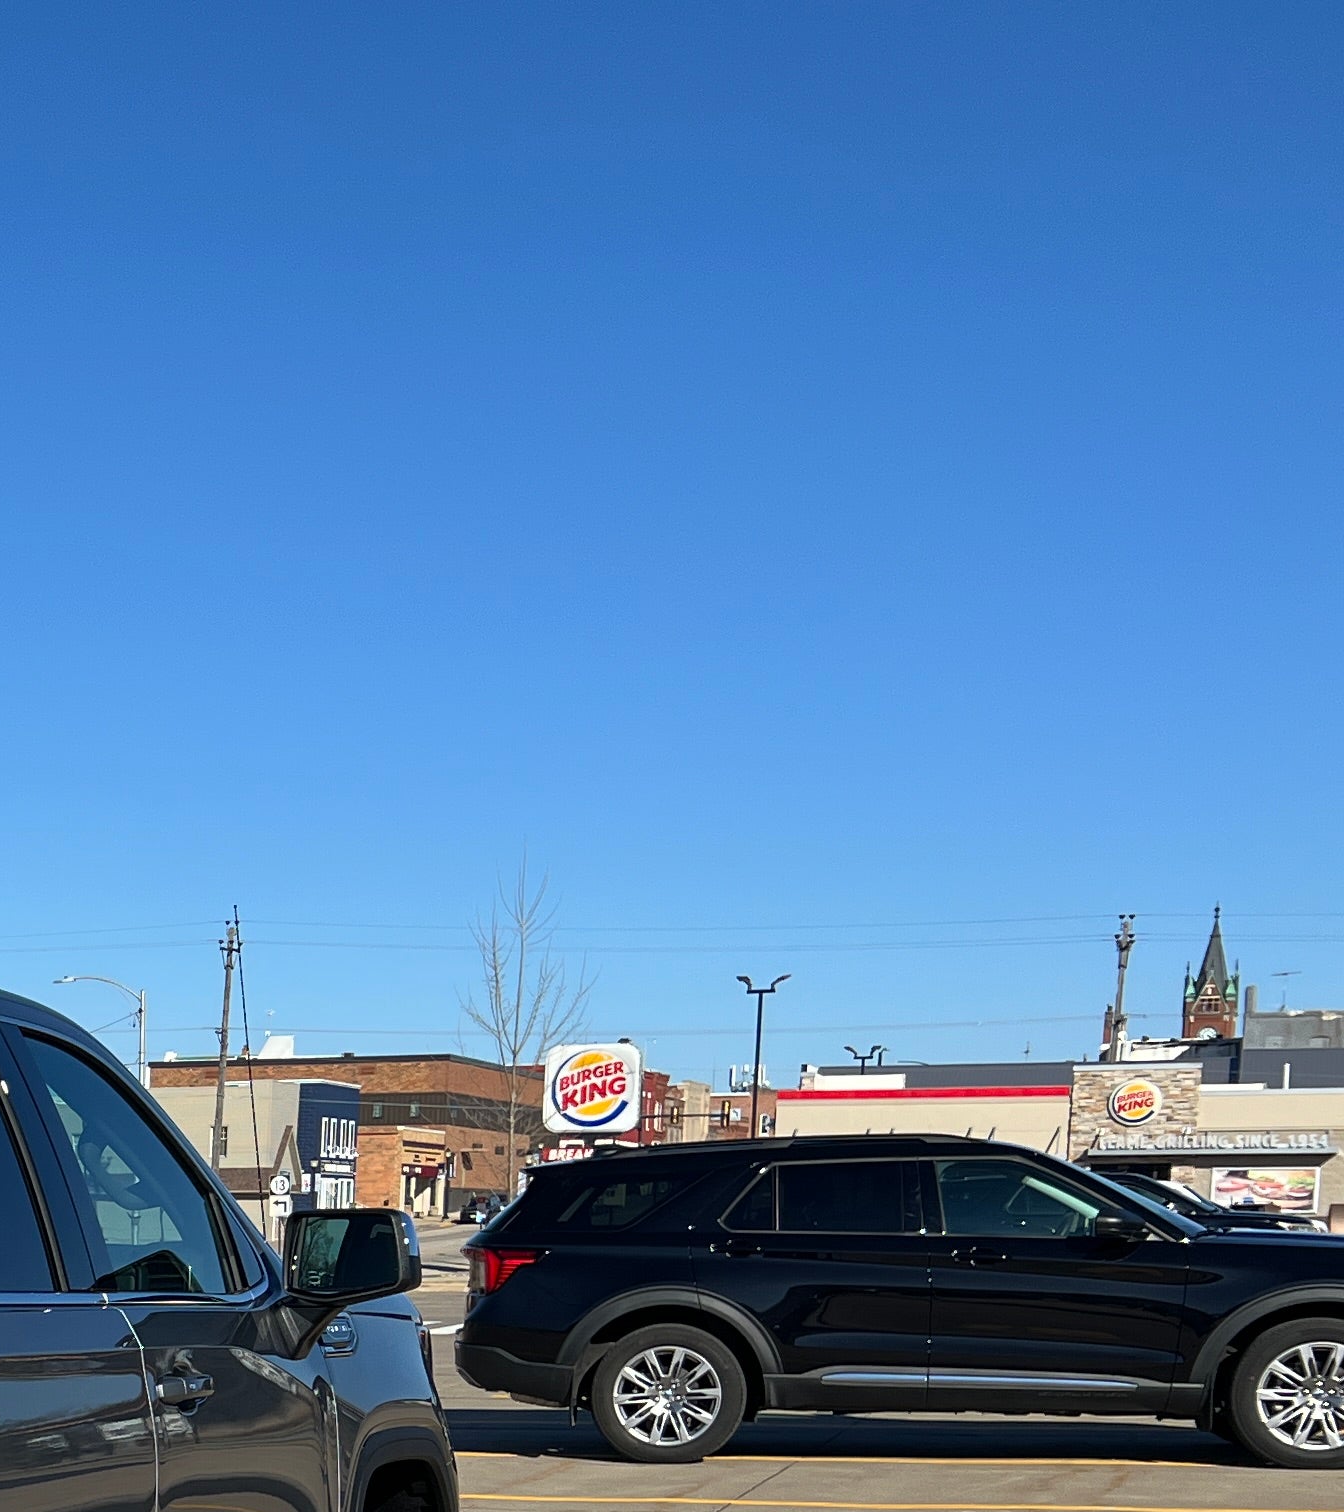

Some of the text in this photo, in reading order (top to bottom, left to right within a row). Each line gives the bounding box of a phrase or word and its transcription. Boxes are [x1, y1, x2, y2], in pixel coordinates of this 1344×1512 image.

[559, 1061, 624, 1092] BURGER
[561, 1076, 626, 1112] KING
[1117, 1098, 1155, 1114] KING
[1235, 1134, 1284, 1149] SINCE
[1288, 1134, 1329, 1149] 1954
[274, 1179, 286, 1191] 13
